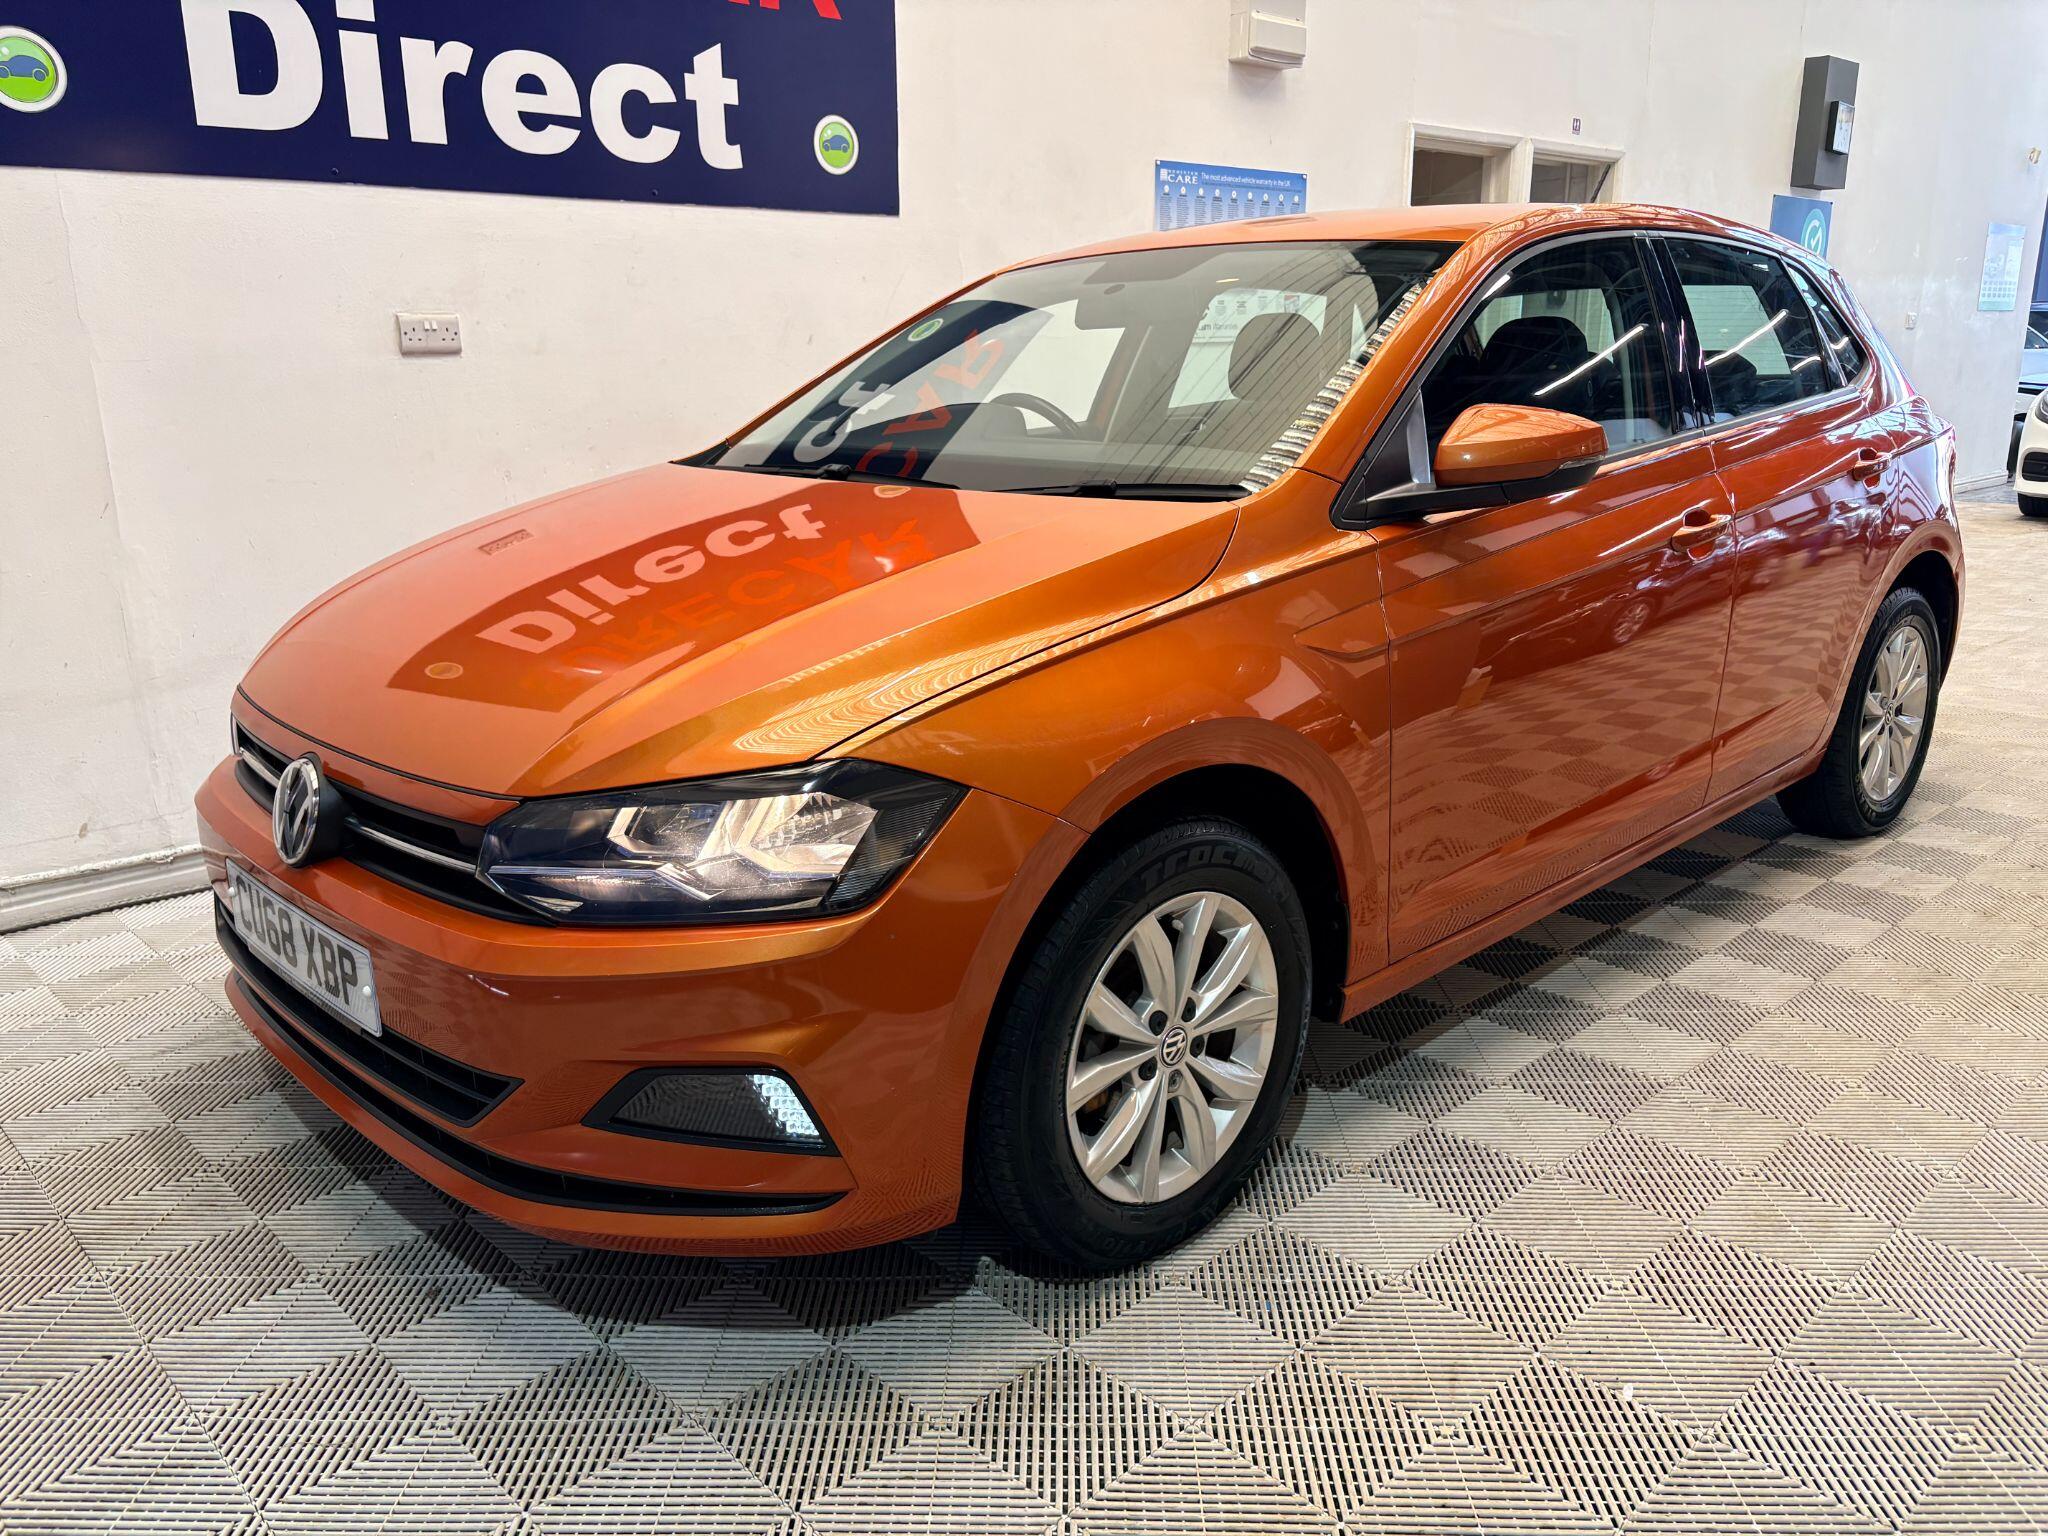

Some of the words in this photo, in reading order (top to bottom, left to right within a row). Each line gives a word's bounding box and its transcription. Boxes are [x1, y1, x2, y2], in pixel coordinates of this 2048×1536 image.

[178, 0, 743, 170] Direct
[1167, 174, 1198, 185] CARE
[235, 875, 298, 968] CU68
[300, 921, 358, 1006] XBP
